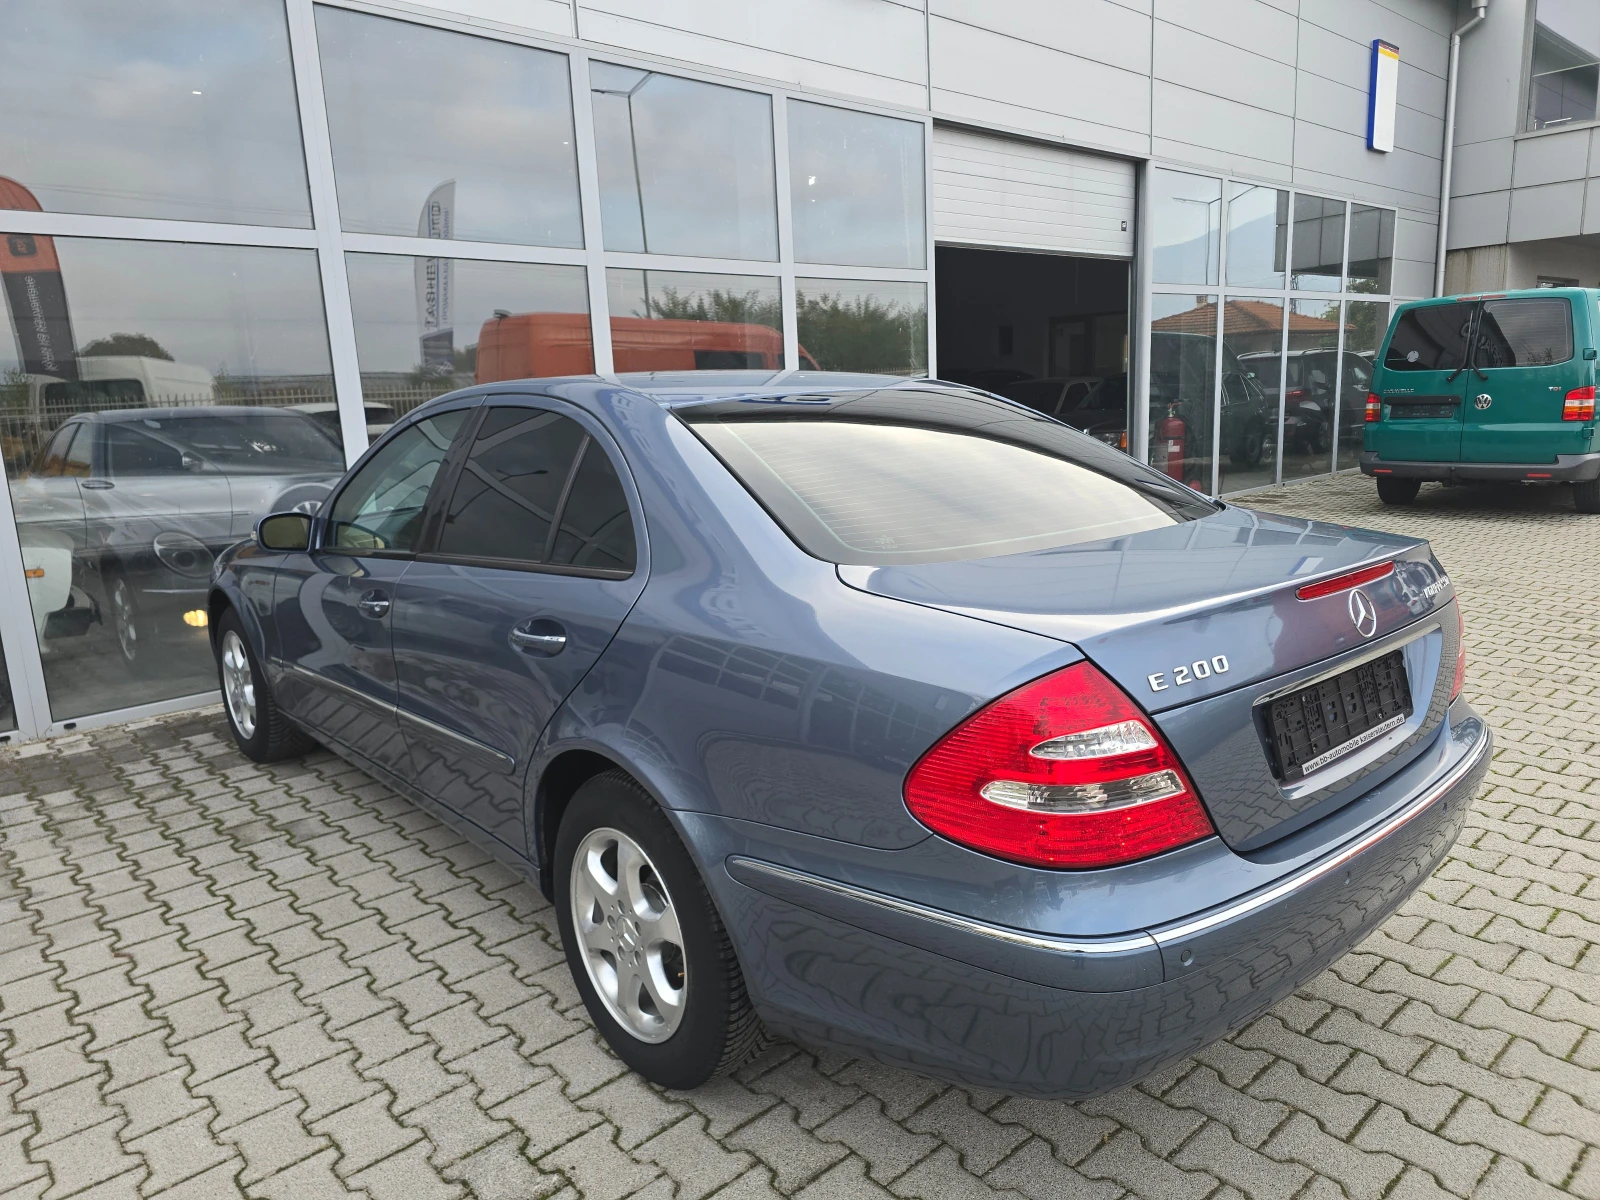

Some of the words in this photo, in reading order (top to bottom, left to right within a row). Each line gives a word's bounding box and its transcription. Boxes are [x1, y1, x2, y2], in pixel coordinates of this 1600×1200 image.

[1147, 672, 1170, 692] E
[1173, 654, 1229, 686] 200
[1304, 739, 1360, 773] www.bb-automobile
